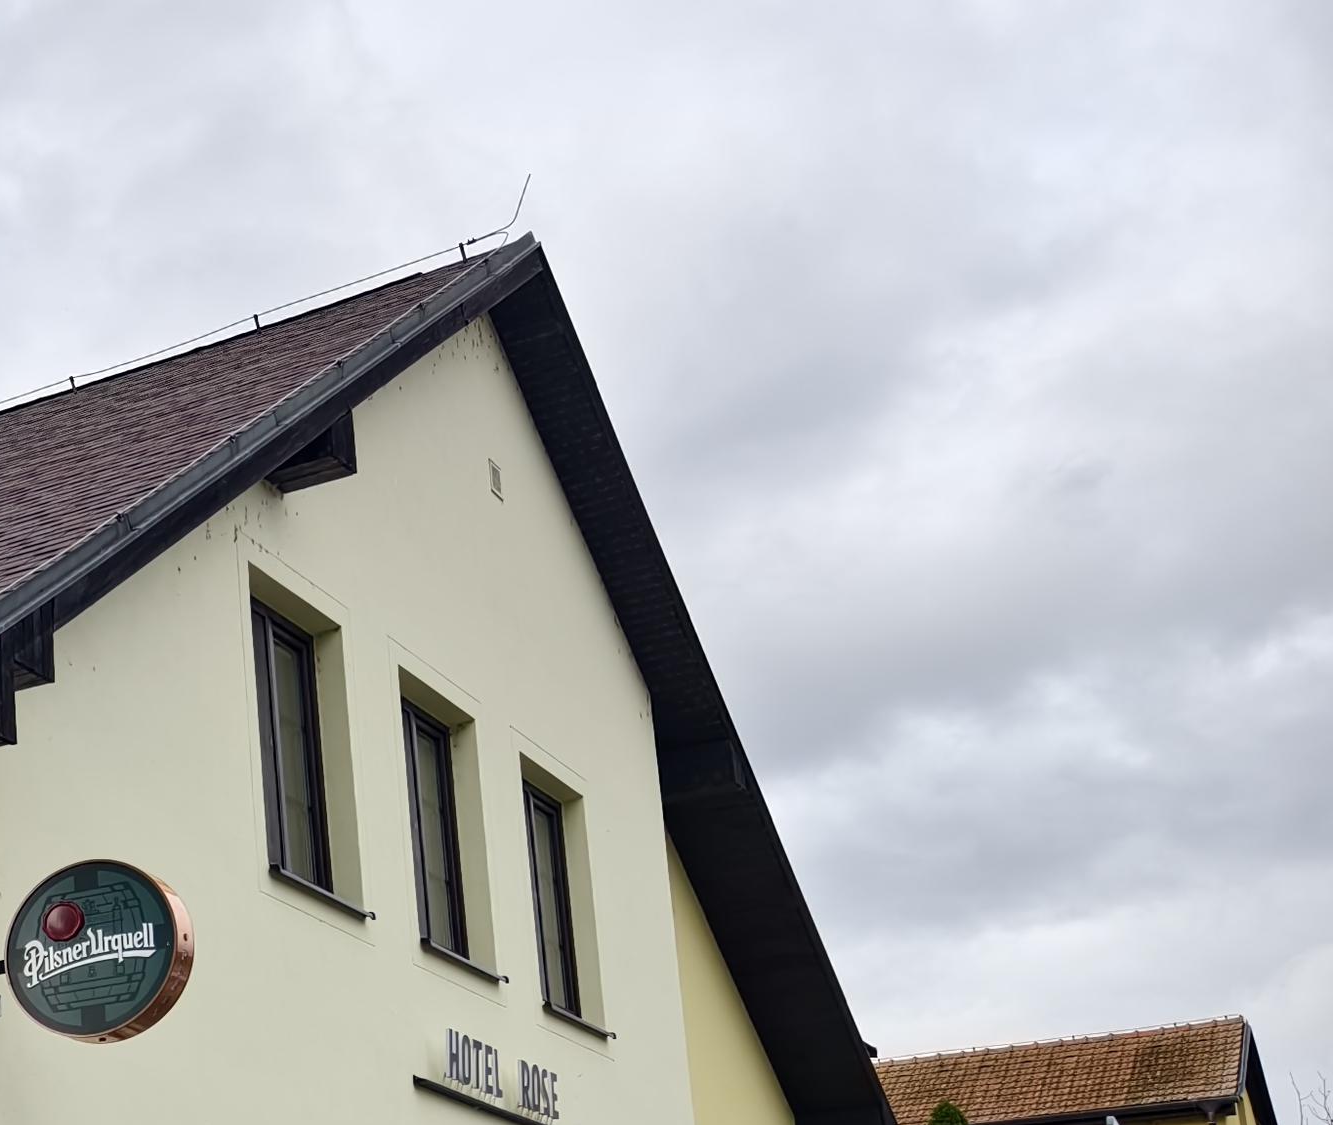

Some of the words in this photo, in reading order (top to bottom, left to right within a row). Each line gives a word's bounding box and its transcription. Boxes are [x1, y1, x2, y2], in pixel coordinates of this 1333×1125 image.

[23, 935, 90, 989] Pilsner
[87, 922, 155, 964] Urquell
[446, 1028, 503, 1098] HOTEL
[517, 1059, 559, 1120] ROSE
